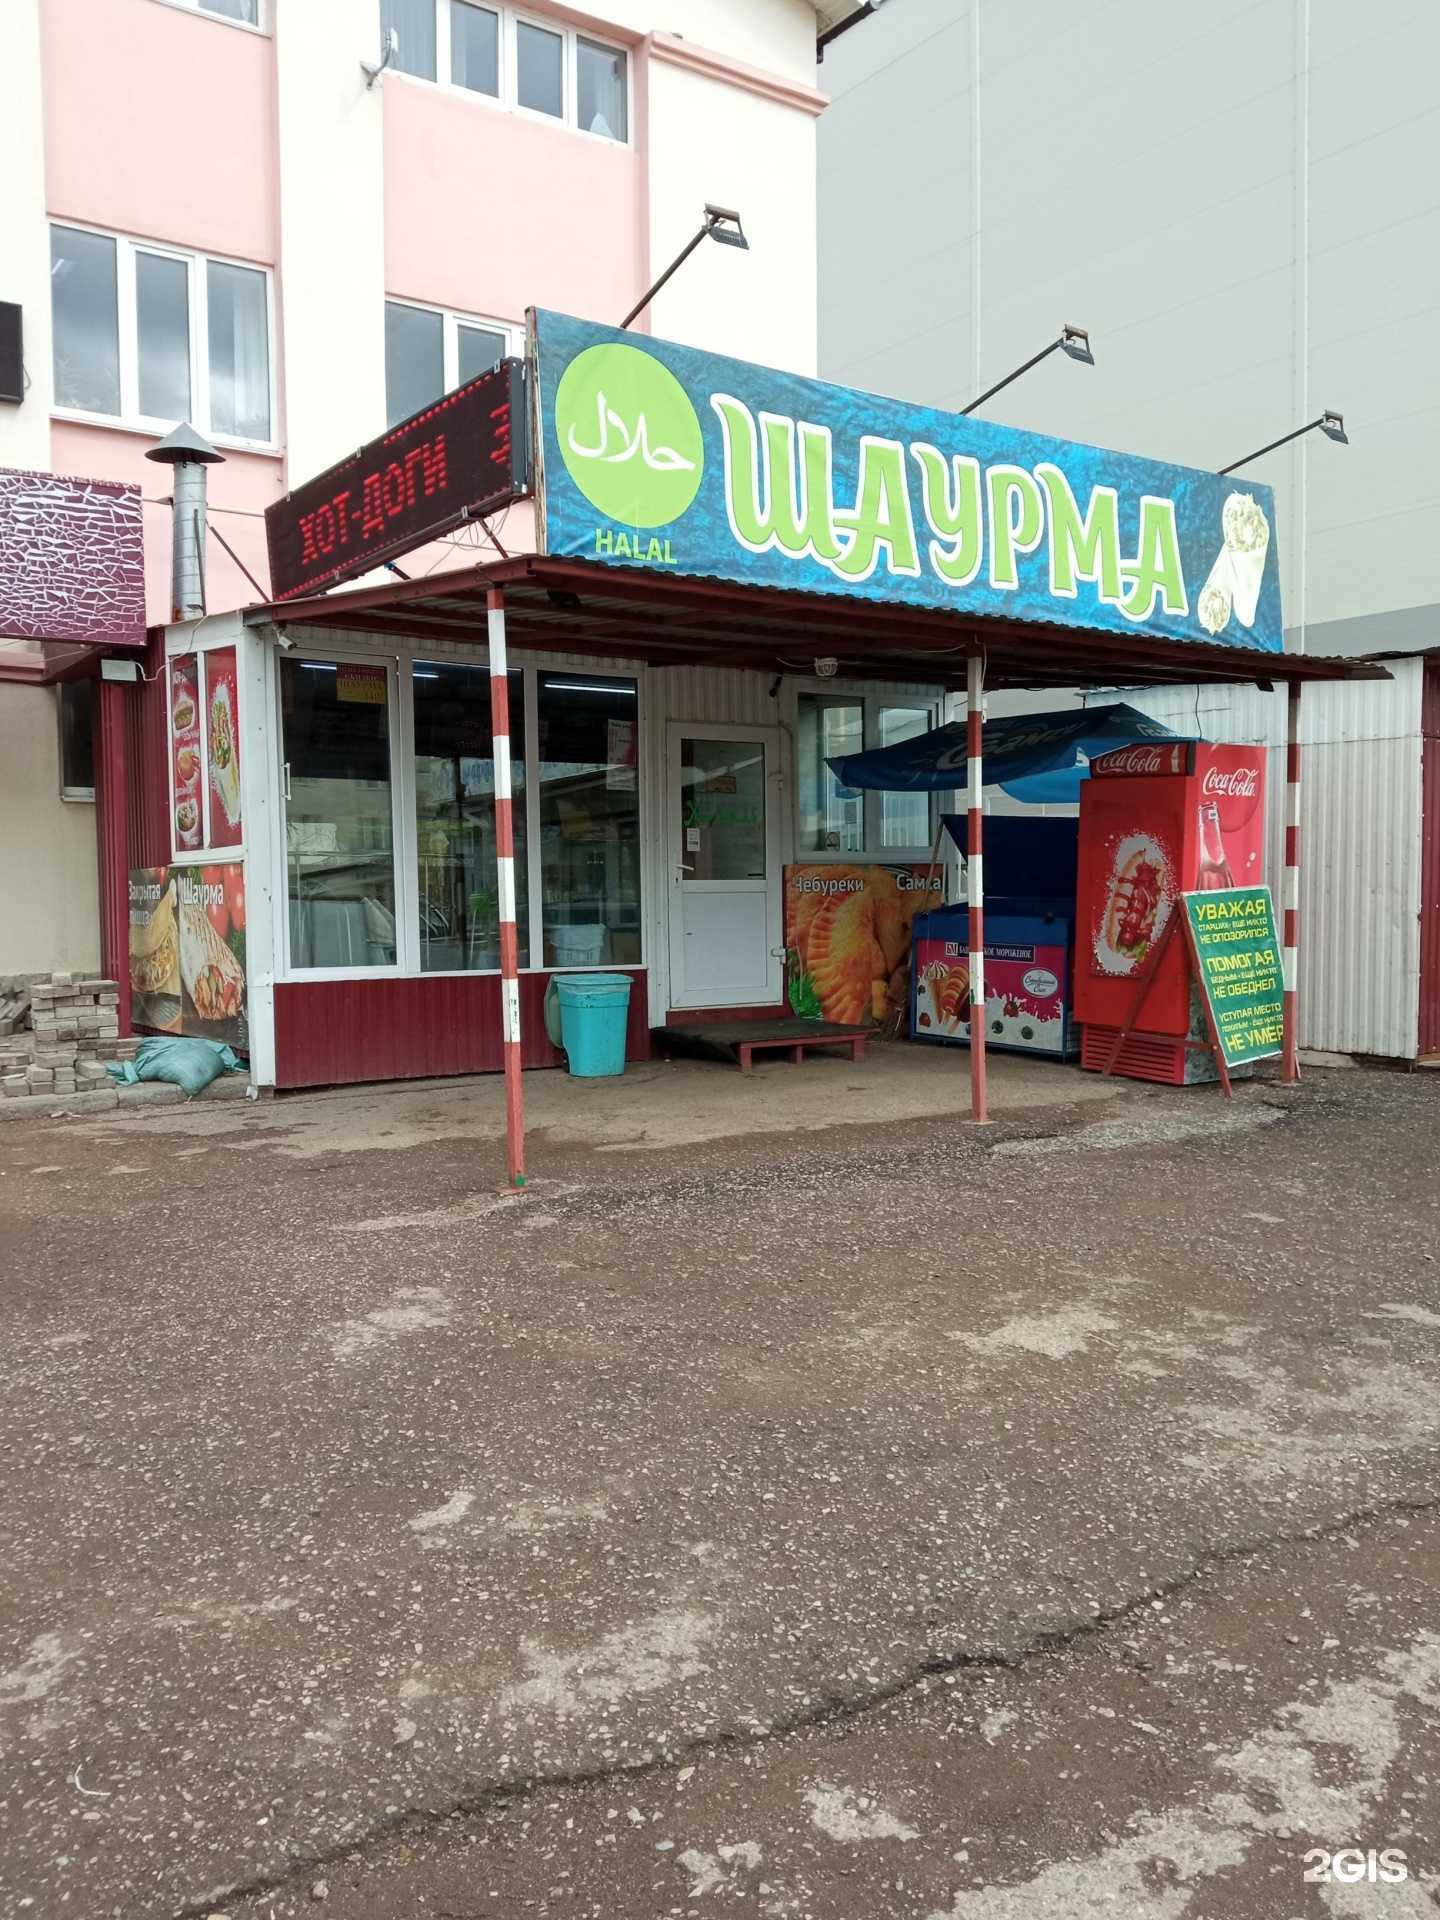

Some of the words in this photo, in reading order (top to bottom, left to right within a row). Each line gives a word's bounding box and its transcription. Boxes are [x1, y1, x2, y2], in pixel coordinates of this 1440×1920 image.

[567, 390, 696, 472] حلال
[710, 392, 1189, 623] ШАУРМА
[595, 528, 678, 566] HALAL
[1203, 767, 1258, 797] Coca-Cola
[183, 878, 224, 908] Шаурма
[796, 877, 864, 897] Чебуреки
[1195, 898, 1266, 921] УВАЖАЯ
[1200, 934, 1212, 945] НЕ
[1212, 928, 1269, 943] ОПОЗОРИЛСЯ
[1206, 950, 1275, 973] ПОМОГАЯ
[1213, 985, 1227, 999] НЕ
[1227, 977, 1276, 996] ОБЕДНЕЛ
[1219, 1007, 1253, 1022] УСТУПАЯ
[1253, 1002, 1281, 1016] МЕСТО
[1225, 1033, 1246, 1053] НЕ
[1244, 1024, 1284, 1047] УМЕР
